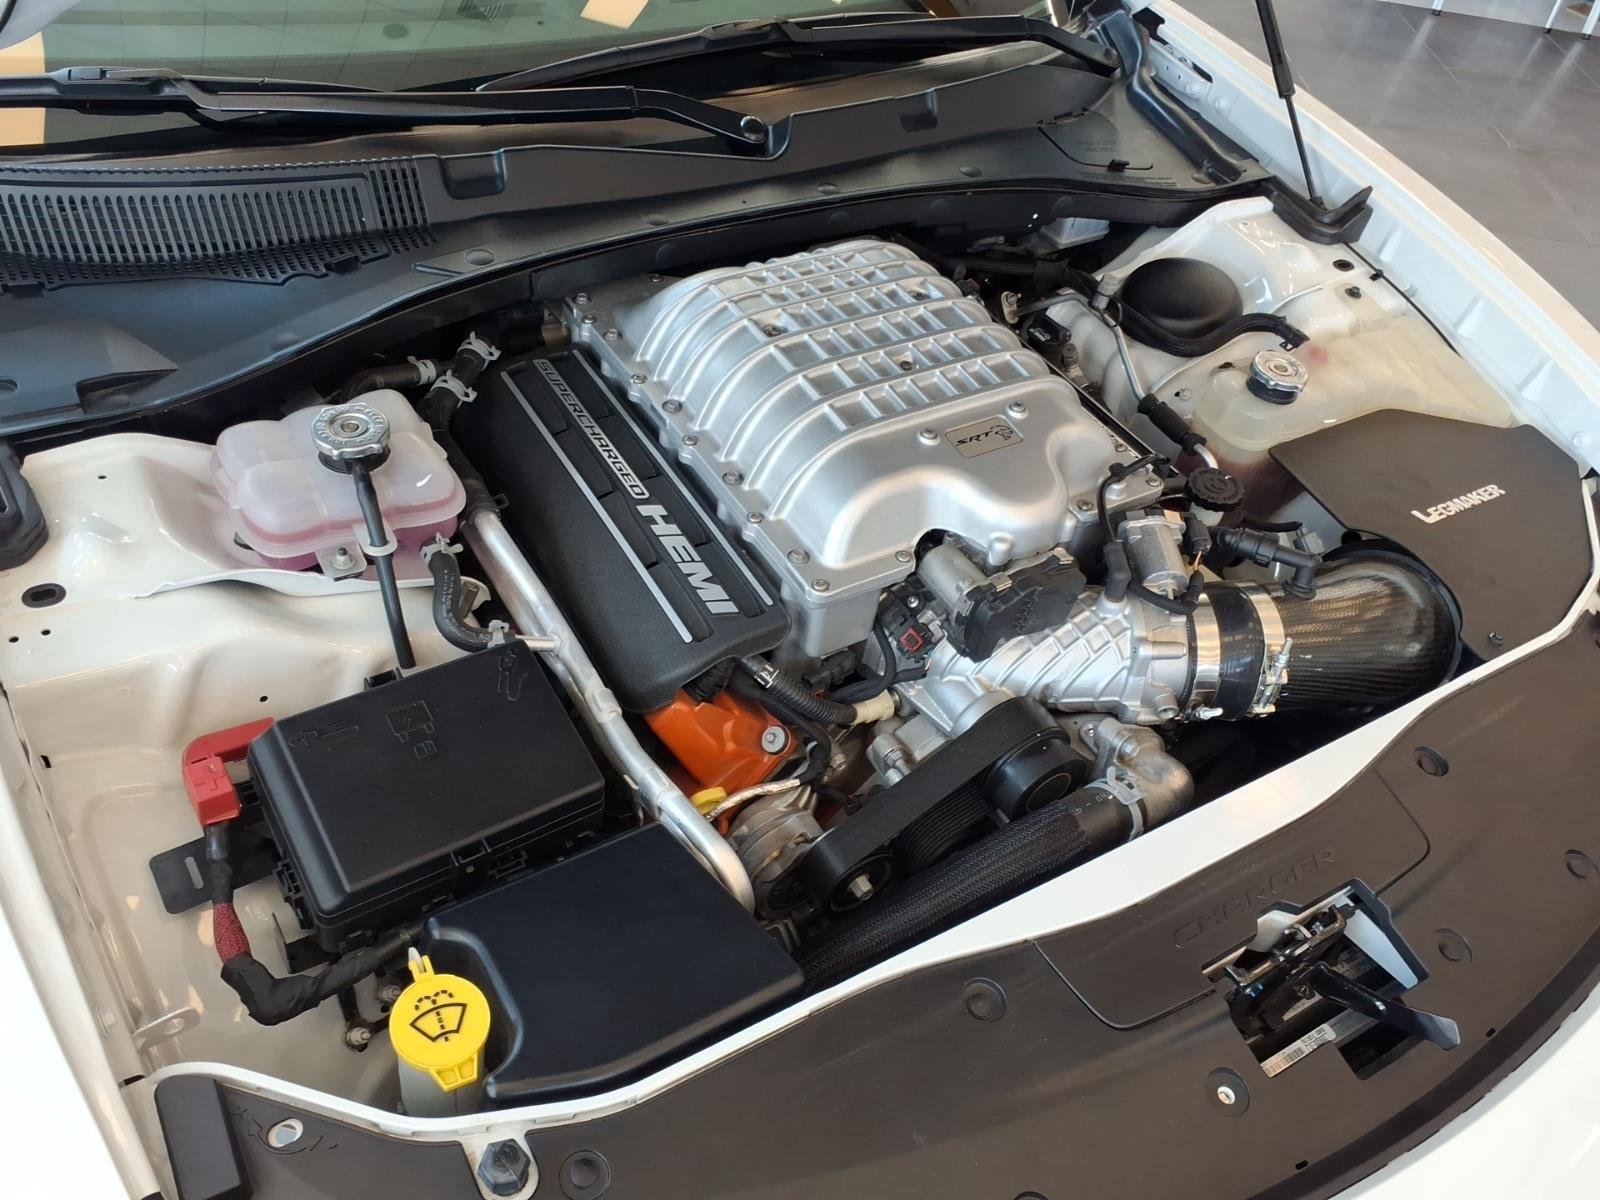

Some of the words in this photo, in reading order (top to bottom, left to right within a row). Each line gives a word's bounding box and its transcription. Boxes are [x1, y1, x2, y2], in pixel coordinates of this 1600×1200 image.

[955, 430, 993, 447] SRT
[534, 359, 650, 499] SUPERCHARGED
[636, 504, 739, 614] HEMI
[1410, 484, 1506, 524] LEGMAKER
[1173, 847, 1336, 948] CHARGER
